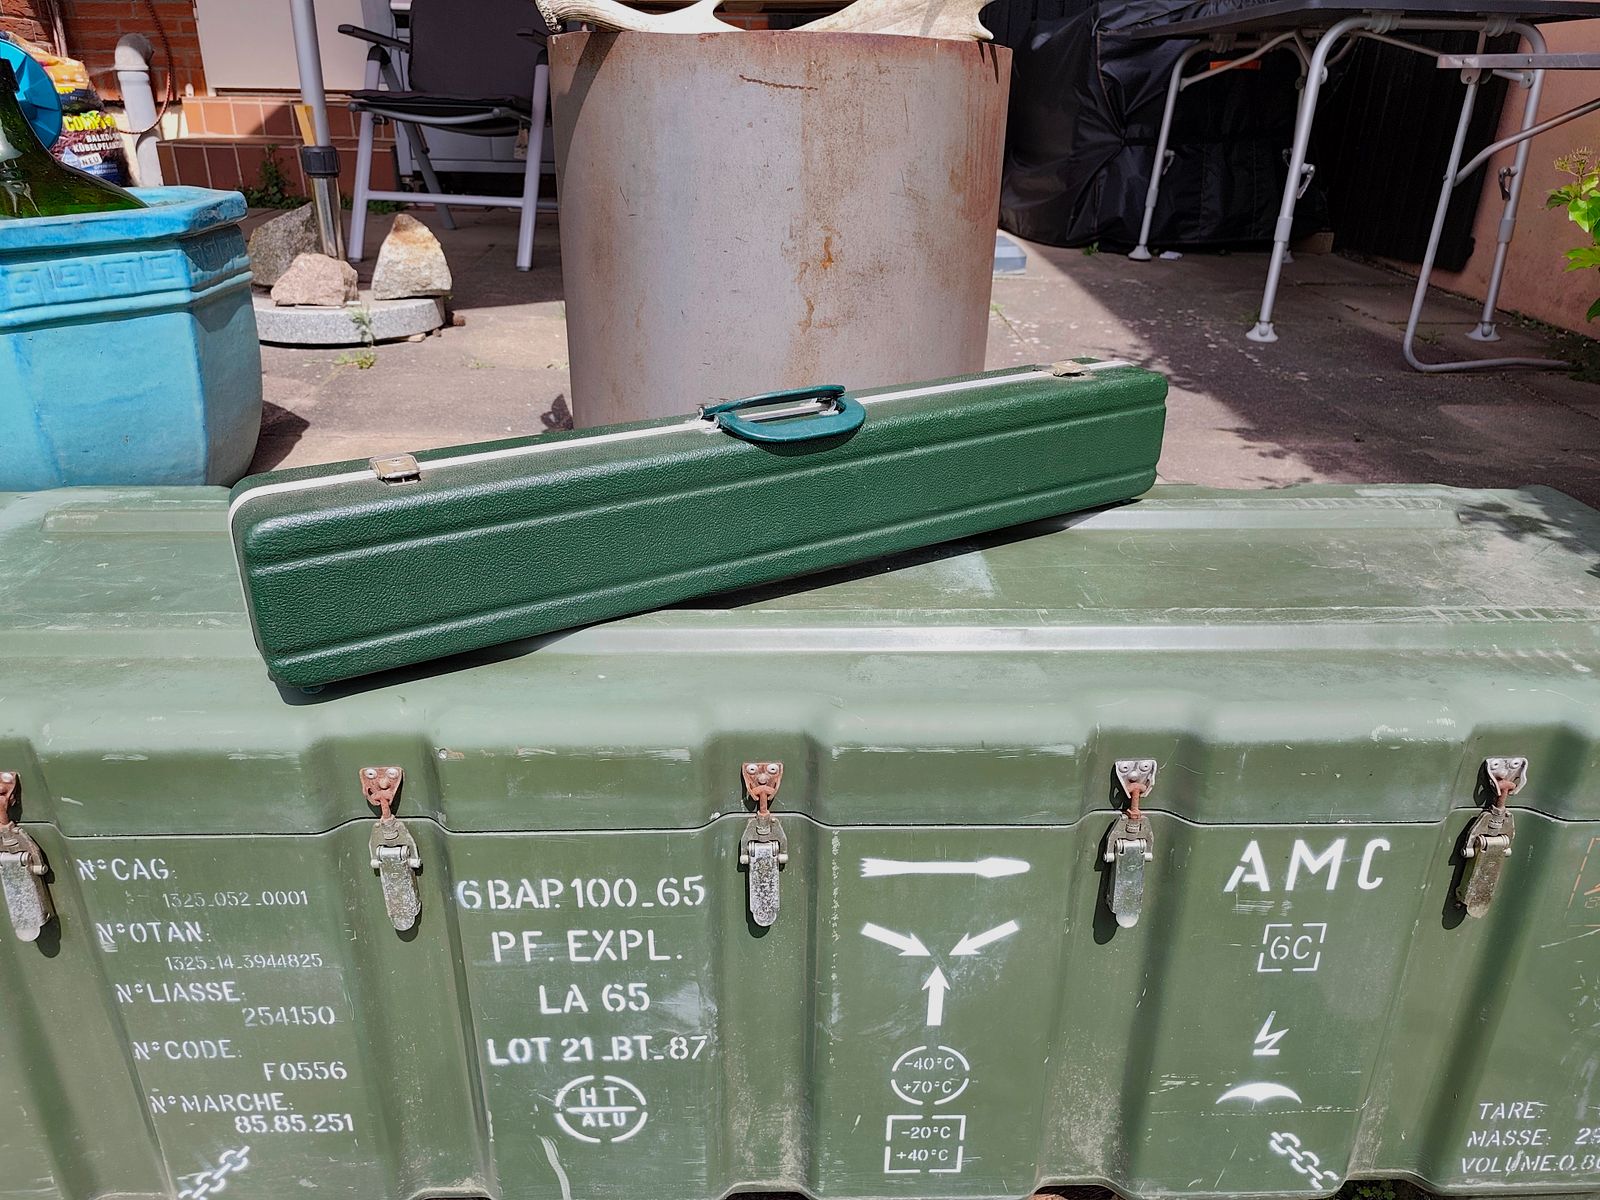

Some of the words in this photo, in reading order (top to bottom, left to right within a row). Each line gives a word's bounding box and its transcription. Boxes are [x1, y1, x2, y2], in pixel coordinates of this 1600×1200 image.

[82, 156, 100, 166] NEU
[1223, 838, 1391, 892] AMC
[491, 930, 554, 962] PF.
[567, 929, 683, 962] EXPL.
[1270, 935, 1312, 960] 6C
[539, 984, 589, 1014] LA
[601, 982, 650, 1013] 65
[241, 1006, 336, 1027] 254150
[487, 1037, 551, 1065] LOT
[234, 1113, 354, 1133] 85.85.251
[581, 1112, 627, 1128] ALU
[1466, 1128, 1551, 1147] MASSE:
